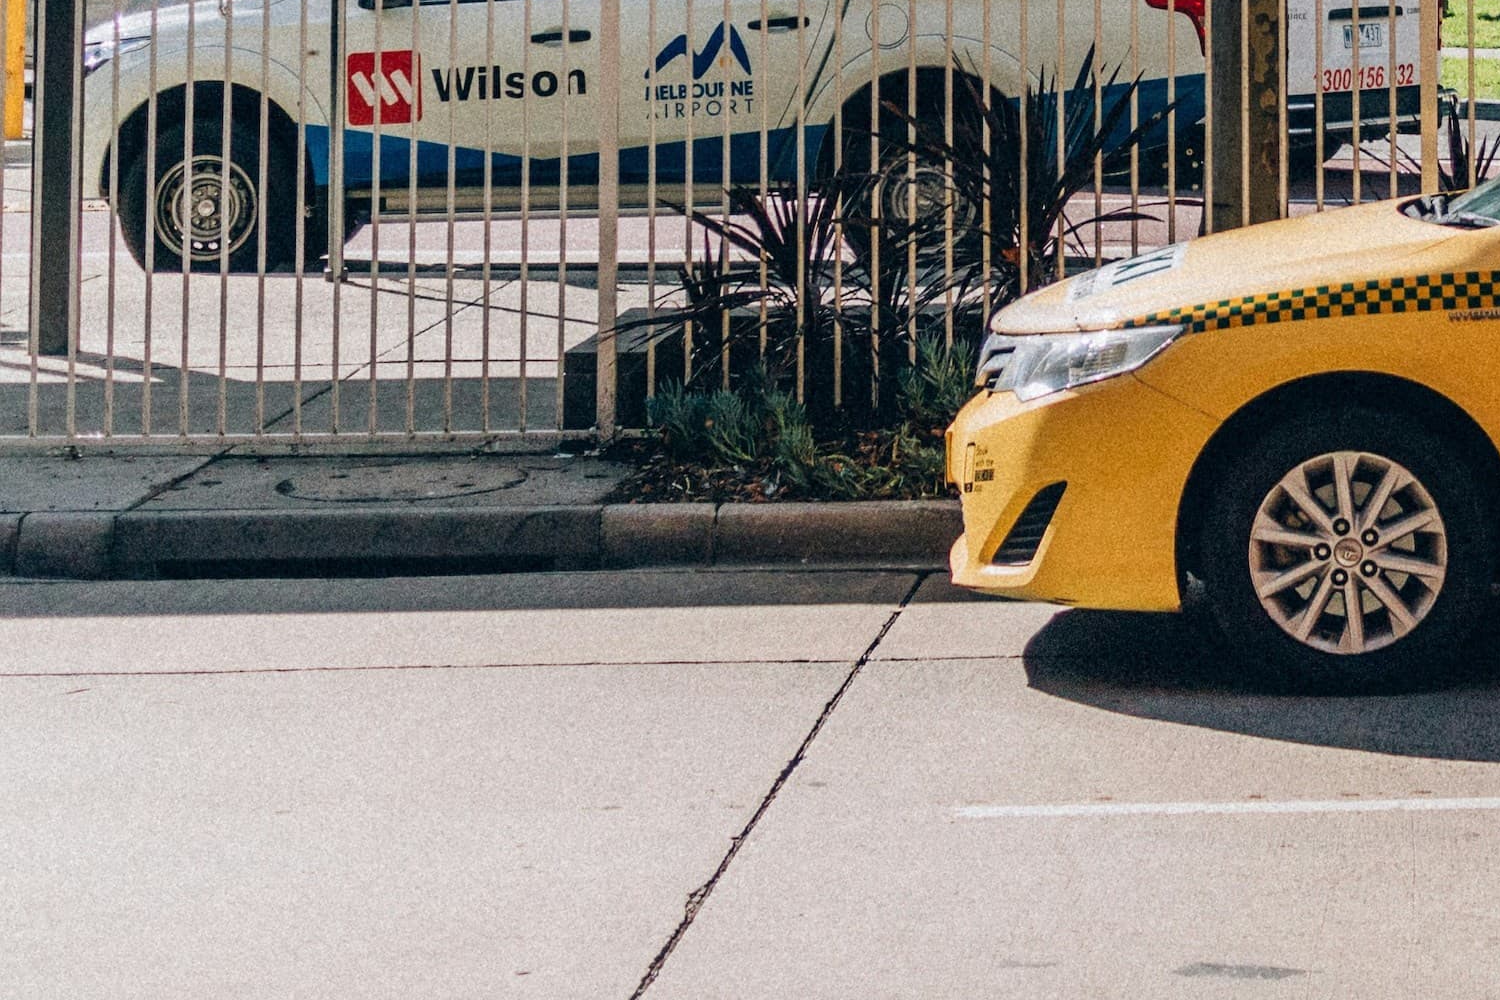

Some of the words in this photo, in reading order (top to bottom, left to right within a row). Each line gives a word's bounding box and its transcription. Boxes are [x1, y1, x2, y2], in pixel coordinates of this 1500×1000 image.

[431, 65, 586, 102] Wilson
[1313, 67, 1352, 92] 300
[1395, 63, 1415, 86] 32
